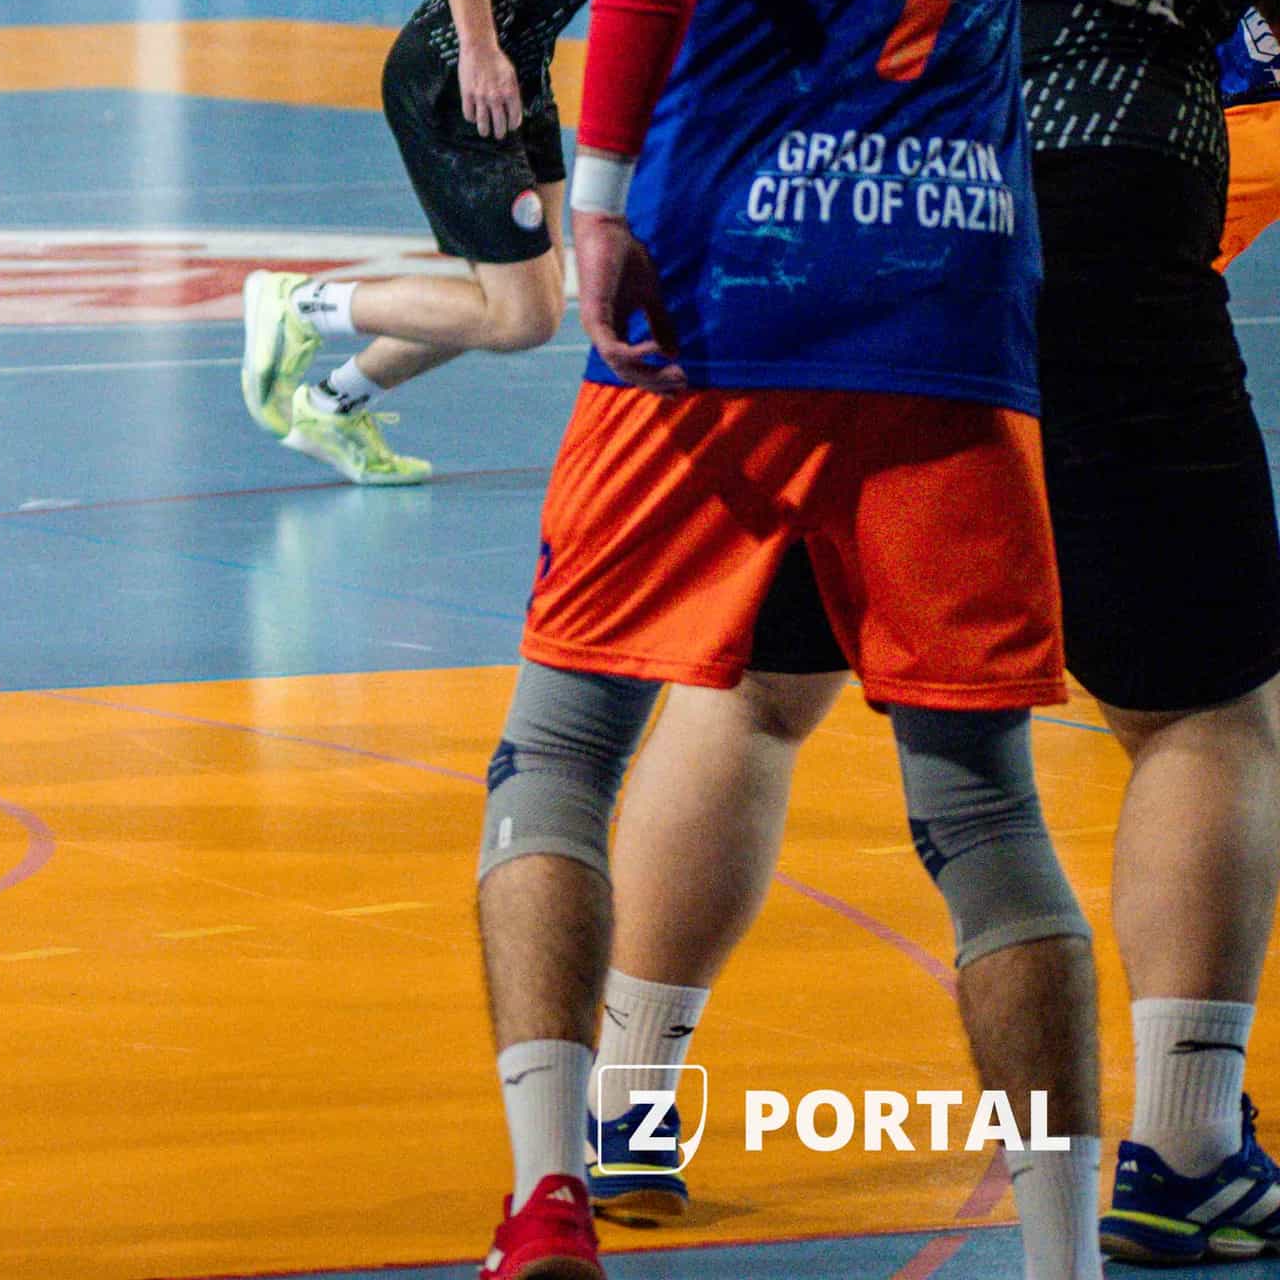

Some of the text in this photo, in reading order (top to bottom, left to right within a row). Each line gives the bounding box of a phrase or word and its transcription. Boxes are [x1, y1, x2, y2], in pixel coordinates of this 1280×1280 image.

[777, 129, 1002, 183] GRAD CAZIN
[746, 175, 1015, 237] CITY OF CAZIN
